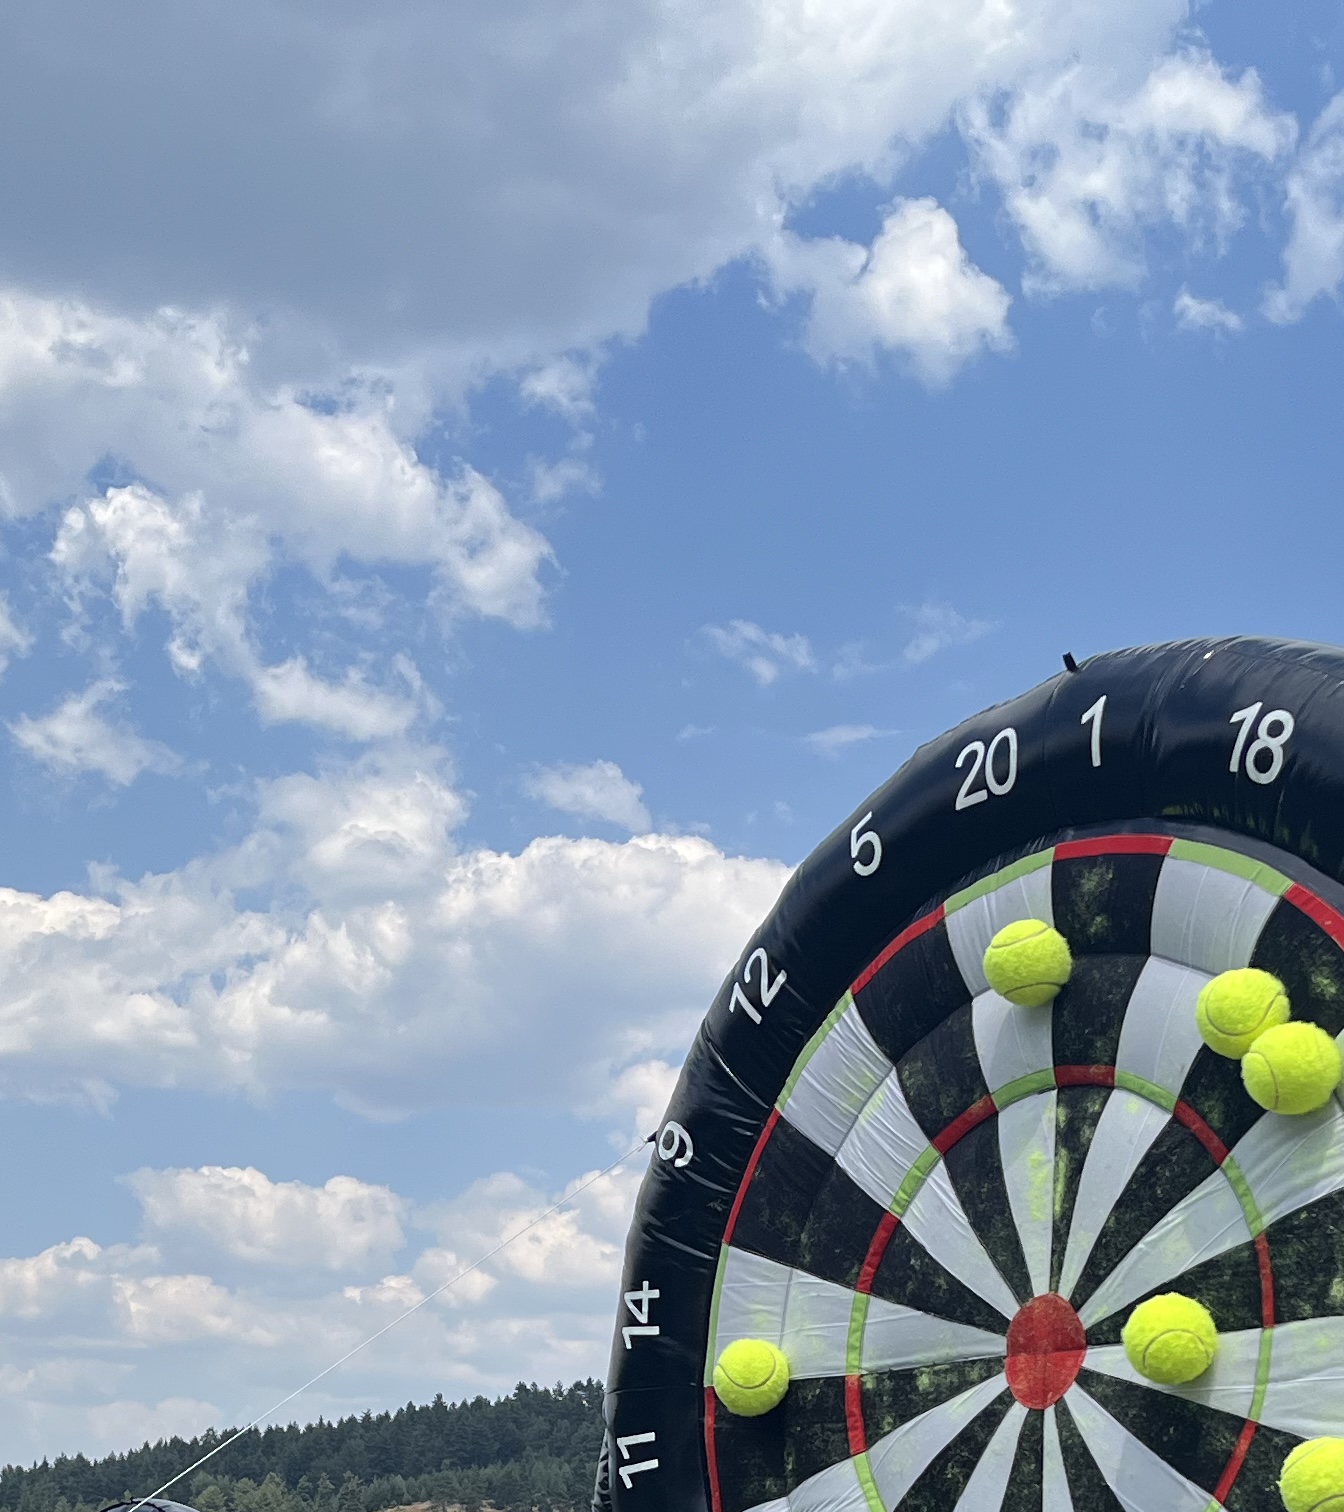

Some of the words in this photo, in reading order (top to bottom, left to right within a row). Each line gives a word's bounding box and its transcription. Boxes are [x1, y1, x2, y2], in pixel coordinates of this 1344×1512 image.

[1080, 695, 1107, 766] 1
[1228, 701, 1295, 785] 18
[956, 727, 1018, 810] 20
[849, 812, 883, 876] 5
[728, 947, 787, 1024] 12
[622, 1280, 660, 1349] 14
[618, 1430, 659, 1489] 11
